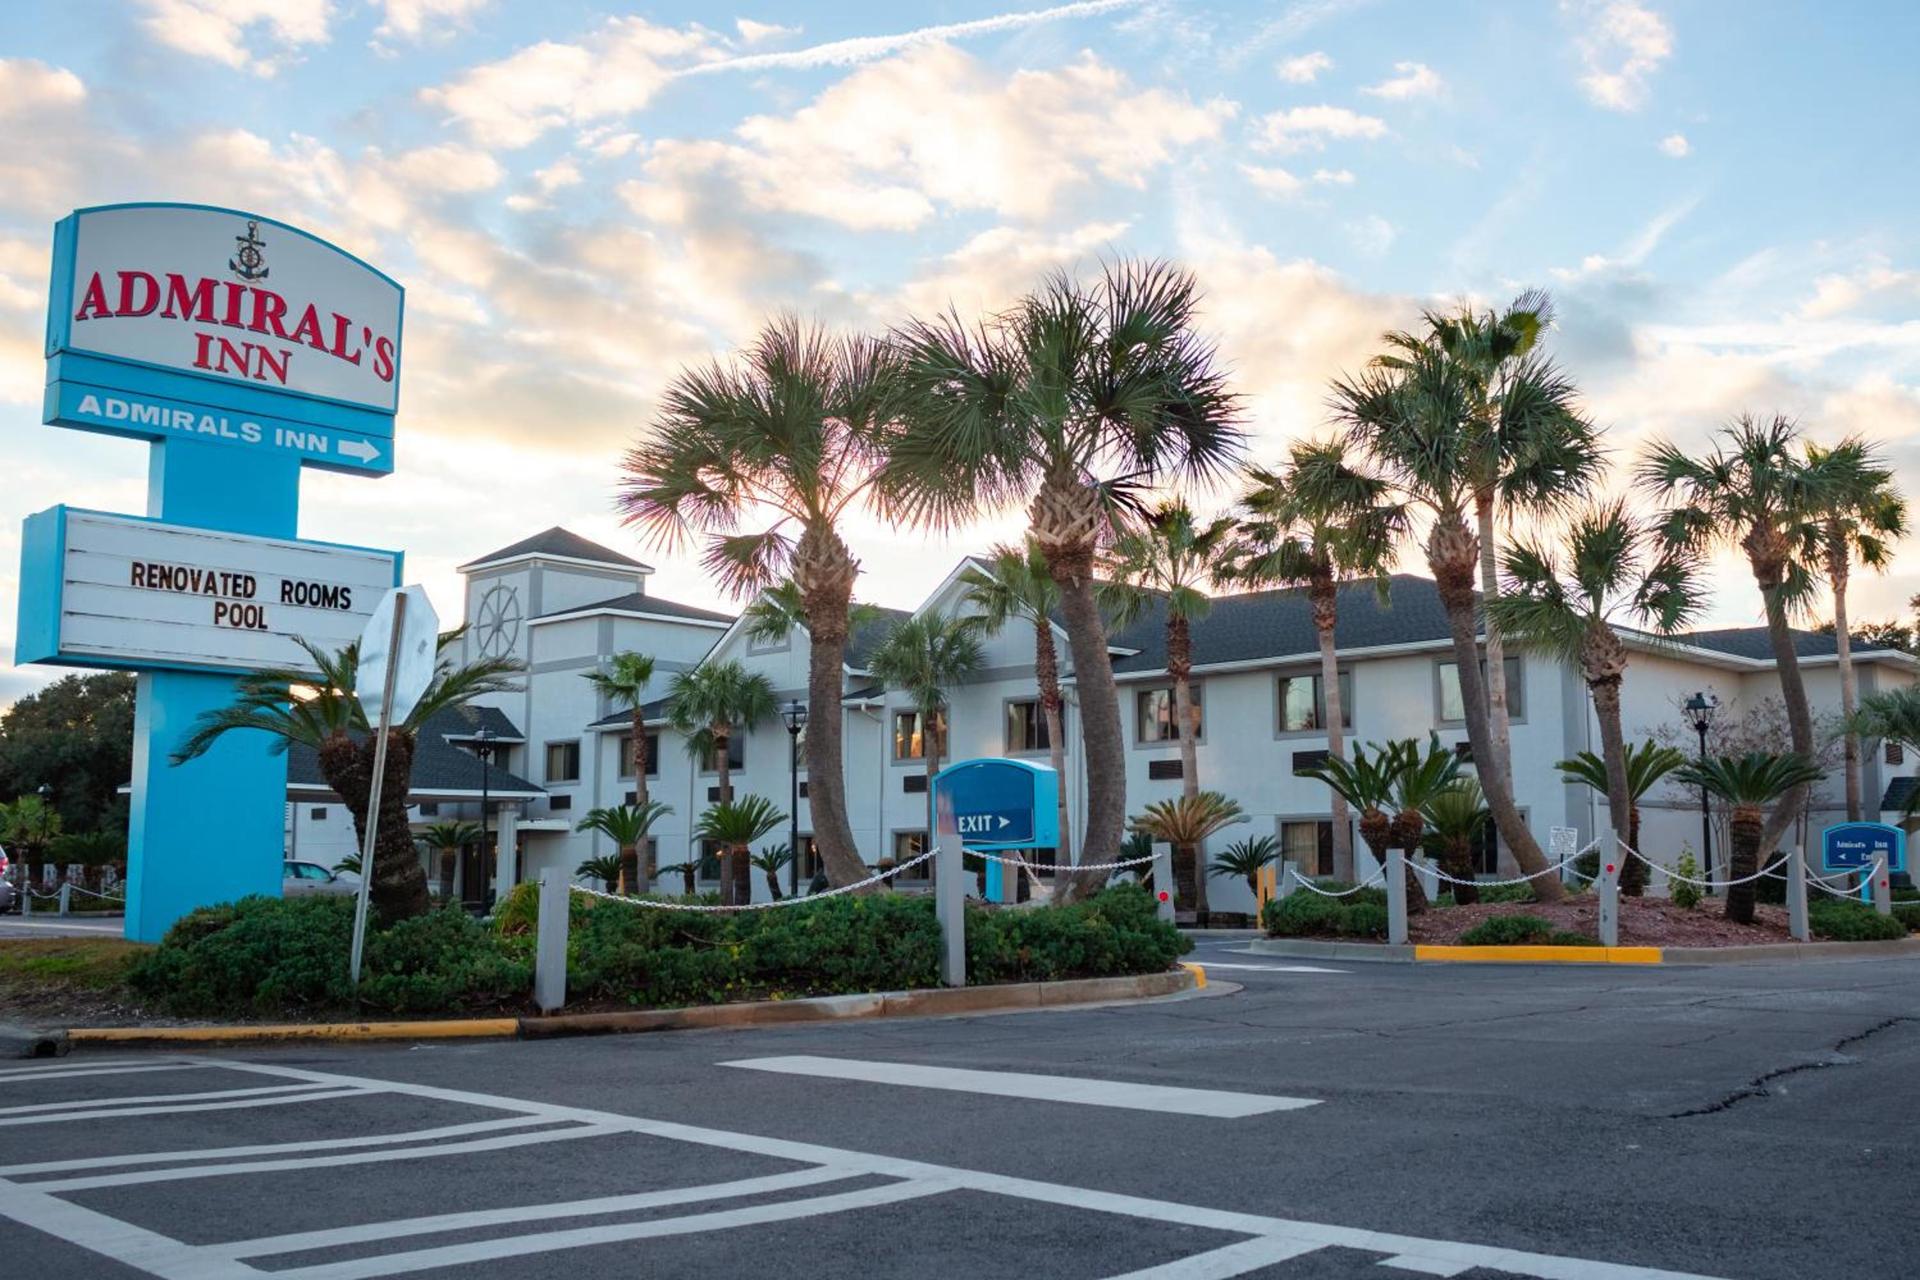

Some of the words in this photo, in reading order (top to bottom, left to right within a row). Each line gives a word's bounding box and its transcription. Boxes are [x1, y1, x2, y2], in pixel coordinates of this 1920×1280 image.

[75, 270, 394, 383] ADMIRAL'S
[193, 332, 292, 384] INN
[77, 395, 262, 443] ADMIRALS
[275, 428, 329, 453] INN
[131, 561, 257, 599] RENOVATED
[280, 580, 352, 610] ROOMS
[214, 602, 268, 630] POOL
[958, 815, 992, 832] EXIT
